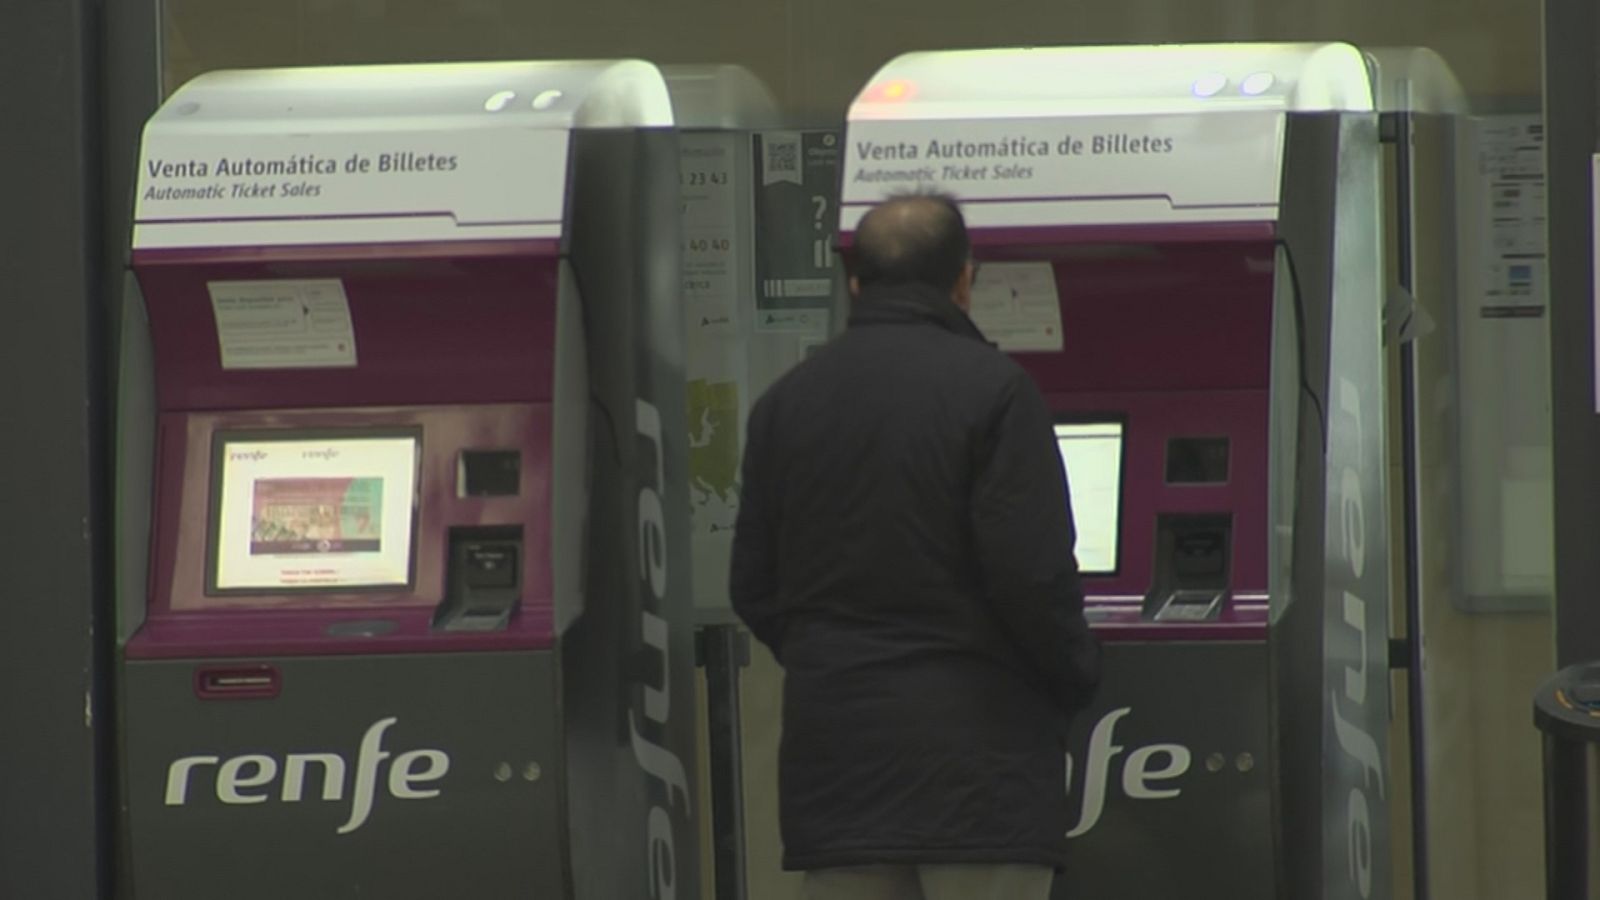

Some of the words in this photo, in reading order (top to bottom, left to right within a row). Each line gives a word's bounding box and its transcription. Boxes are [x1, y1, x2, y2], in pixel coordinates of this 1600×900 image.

[147, 158, 208, 178] Venta
[216, 155, 337, 176] Automática
[344, 153, 370, 174] de
[378, 152, 458, 173] Billetes
[853, 167, 935, 183] Automatic
[941, 165, 987, 182] Ticket
[992, 164, 1033, 180] Sales
[856, 142, 918, 161] Venta
[926, 138, 1050, 159] Automática
[1057, 137, 1084, 156] de
[1091, 135, 1173, 155] Billetes
[144, 184, 225, 202] Automatic
[231, 183, 275, 199] Ticket
[280, 182, 321, 198] Sales
[628, 398, 691, 900] renfe
[1332, 378, 1386, 899] renfe
[165, 716, 450, 834] renfe
[1065, 707, 1191, 838] fe
